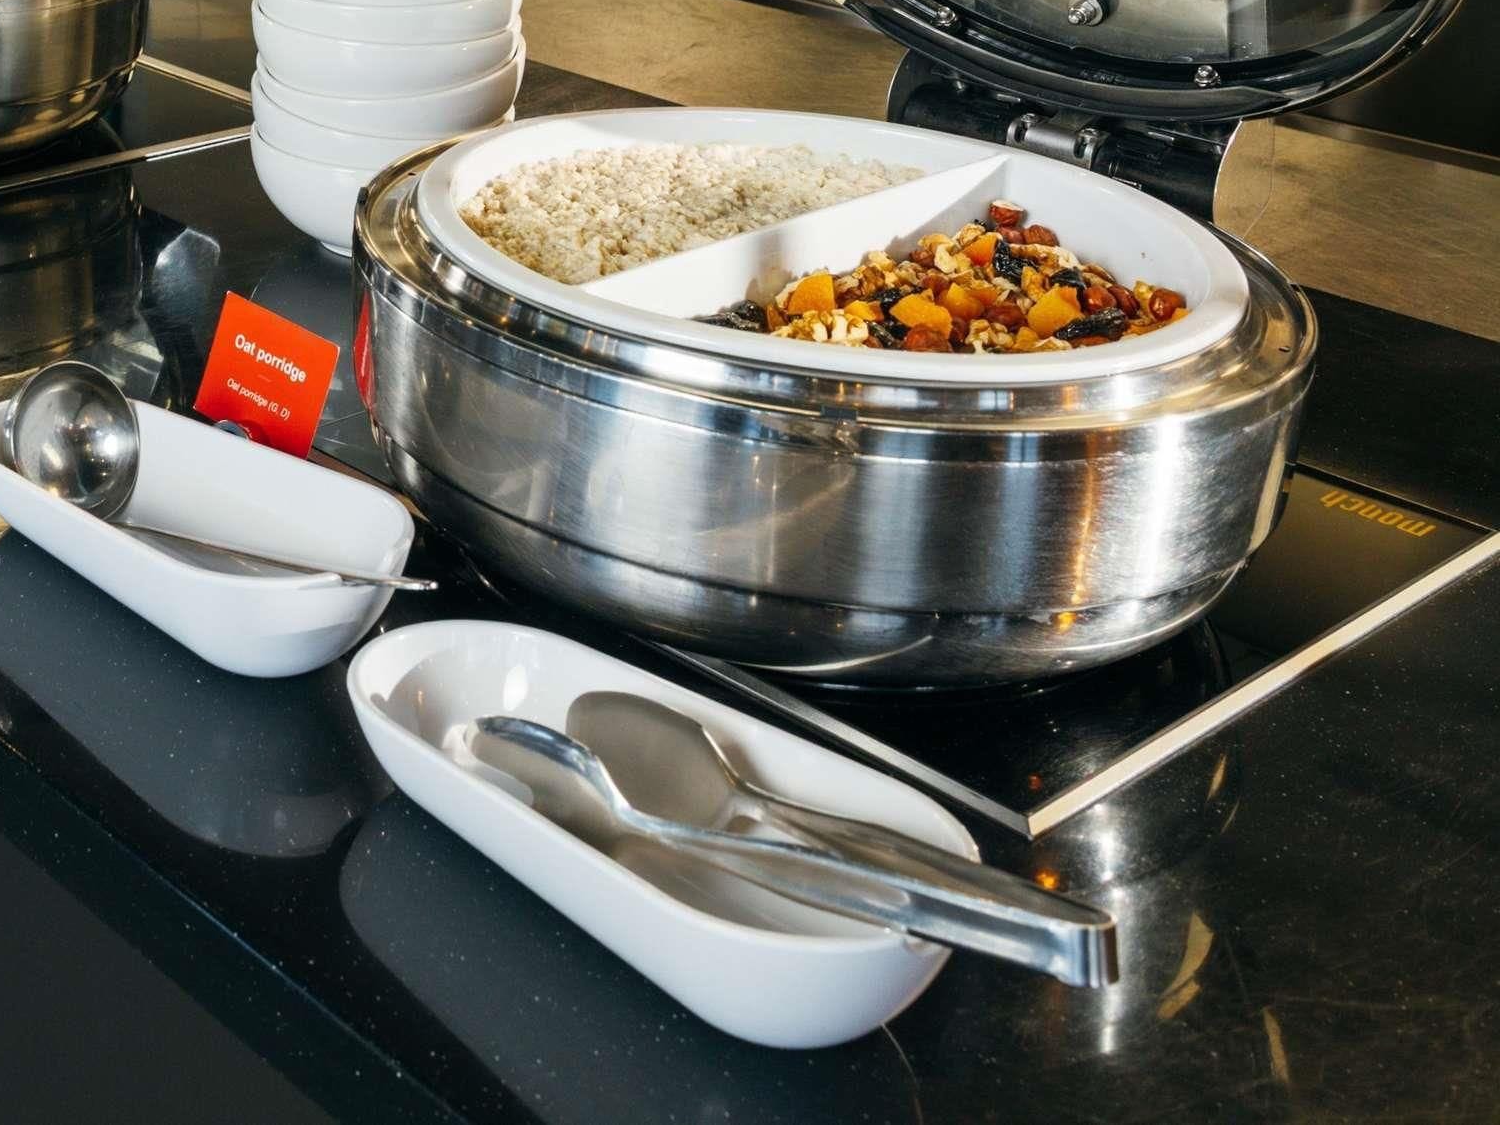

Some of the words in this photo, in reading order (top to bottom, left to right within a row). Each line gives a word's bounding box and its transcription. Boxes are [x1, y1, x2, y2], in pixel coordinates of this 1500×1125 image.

[235, 334, 256, 356] Oat
[257, 348, 306, 382] porridge
[227, 378, 240, 391] Oat
[240, 385, 268, 407] porridge
